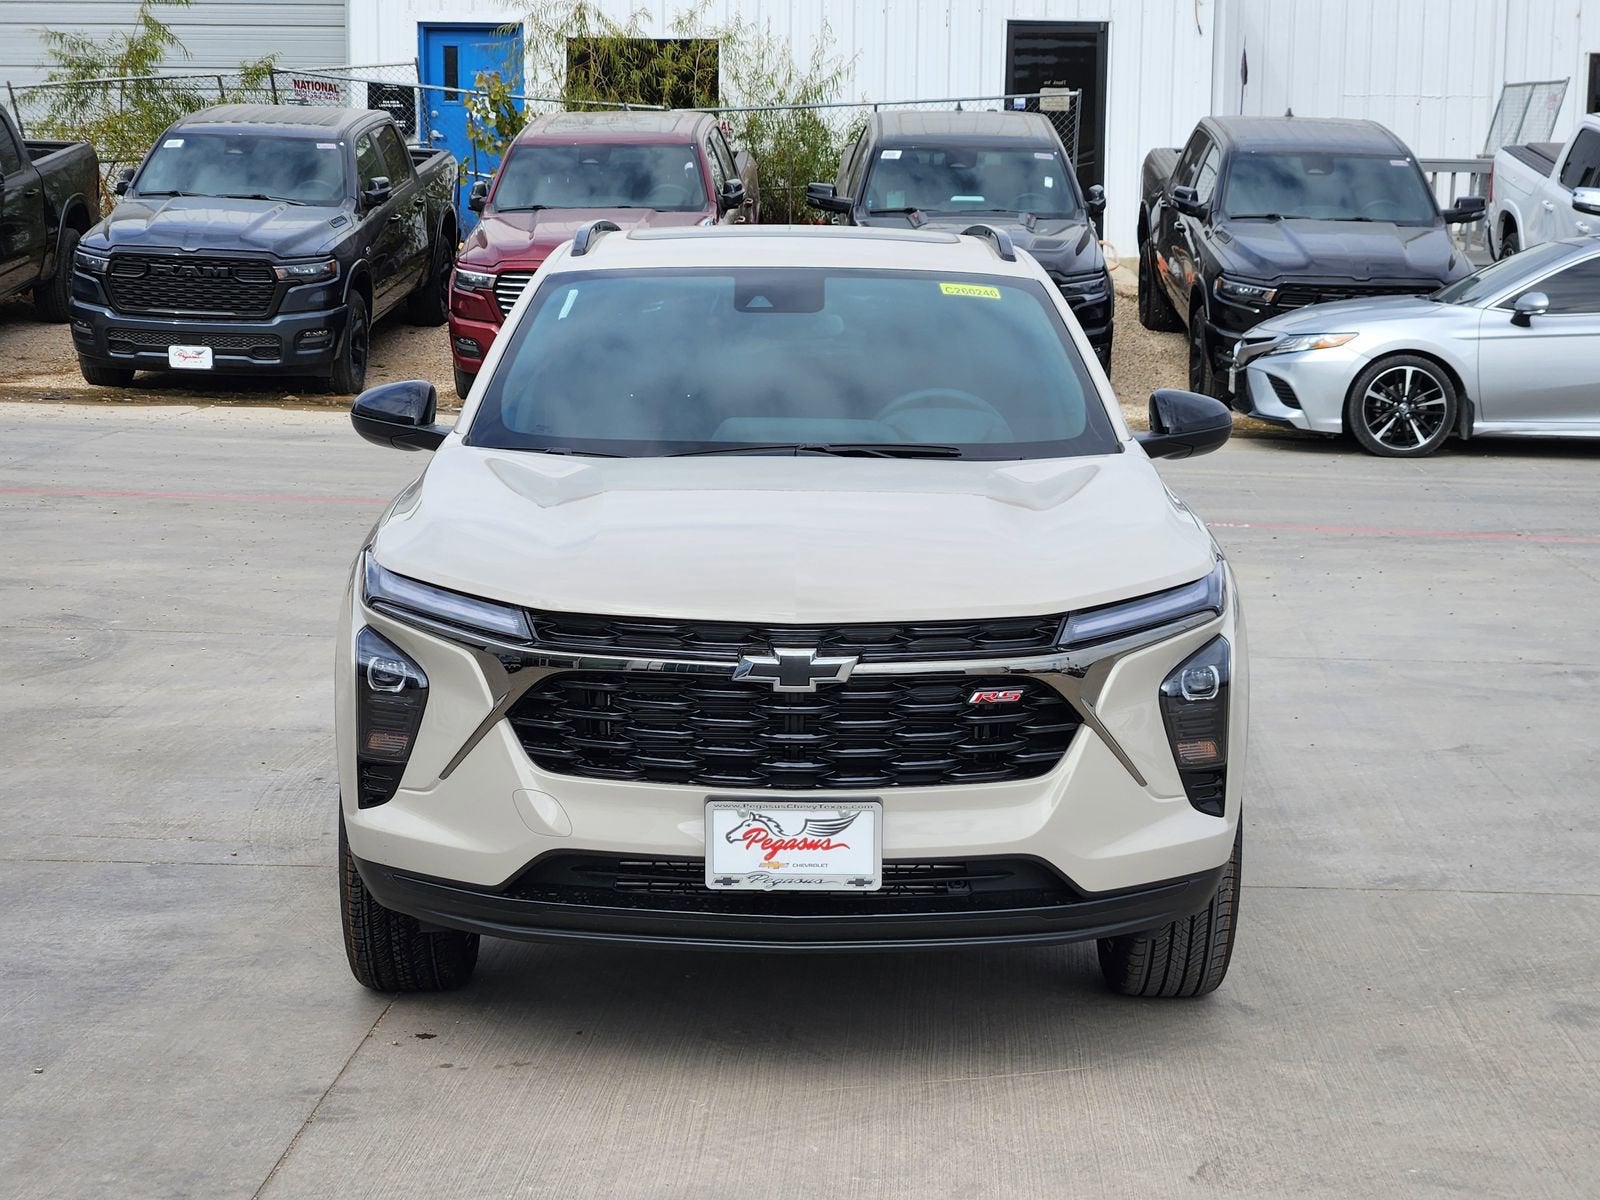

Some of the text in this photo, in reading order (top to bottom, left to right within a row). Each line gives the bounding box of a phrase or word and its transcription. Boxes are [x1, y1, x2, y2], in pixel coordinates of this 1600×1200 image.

[293, 79, 340, 94] NATIONAL
[149, 263, 233, 278] RAM
[968, 690, 1023, 704] RS
[742, 827, 850, 861] Pegasus
[747, 874, 832, 888] Pegasus
